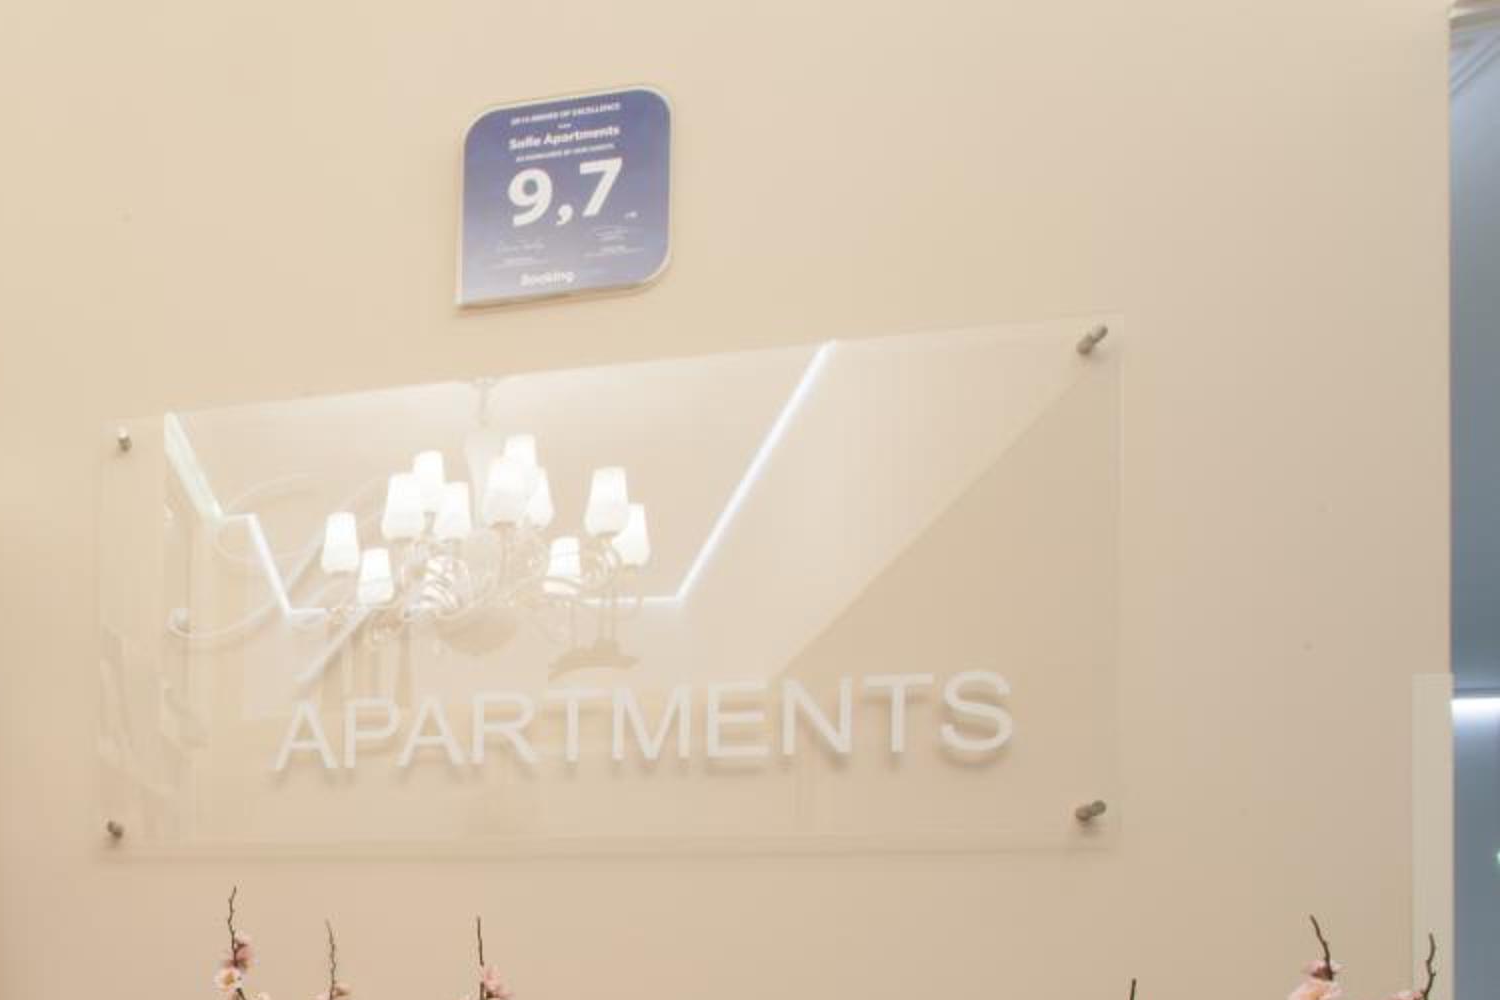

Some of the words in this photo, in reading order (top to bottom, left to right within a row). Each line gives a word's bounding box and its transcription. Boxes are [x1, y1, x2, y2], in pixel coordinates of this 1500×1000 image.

[544, 126, 620, 145] Apartments
[508, 157, 623, 227] 9,7
[273, 668, 1015, 775] APARTMENTS
